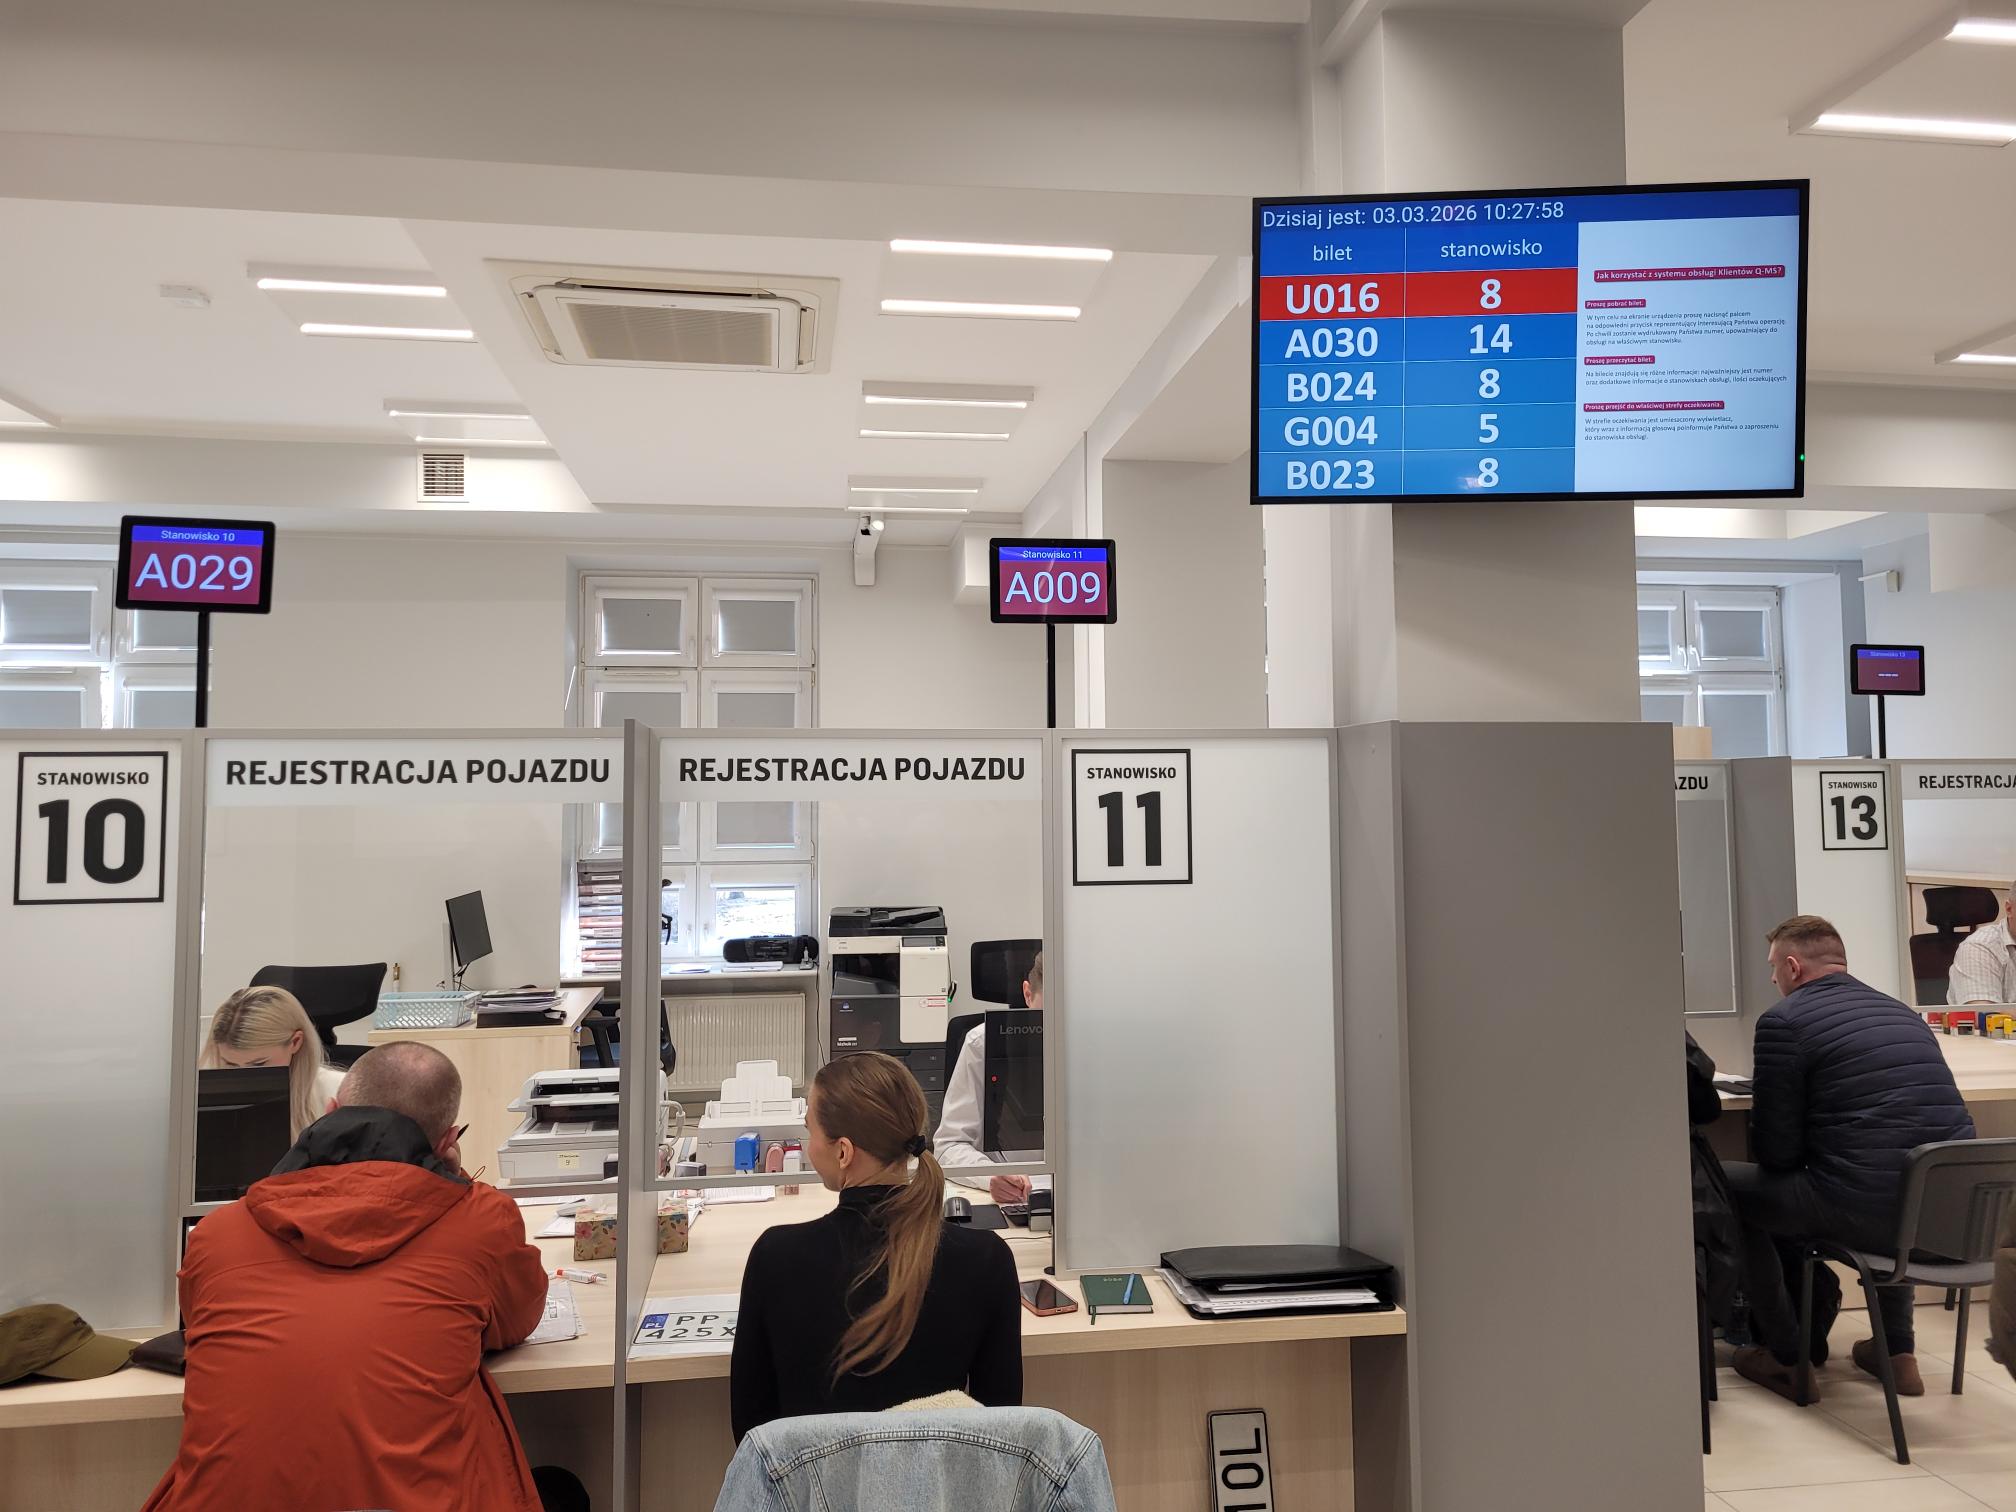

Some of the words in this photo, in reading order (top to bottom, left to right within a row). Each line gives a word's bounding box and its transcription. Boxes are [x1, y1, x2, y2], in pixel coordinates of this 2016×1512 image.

[1263, 209, 1322, 230] Dzisiaj
[1327, 209, 1366, 229] jest:
[1372, 204, 1477, 224] 03.03.2026
[1483, 201, 1564, 221] 10:27:58
[1313, 244, 1352, 261] bilet
[1440, 238, 1543, 257] stanowisko
[1611, 271, 1646, 280] korzystać
[1688, 269, 1716, 277] obsługi
[1287, 282, 1379, 314] U016
[1480, 278, 1502, 309] 8
[1285, 326, 1378, 358] A030
[1470, 323, 1513, 354] 14
[1288, 371, 1376, 401] B024
[1479, 368, 1501, 398] 8
[1285, 415, 1377, 446] G004
[1479, 413, 1499, 443] 5
[1288, 460, 1375, 490] B023
[1477, 458, 1499, 488] 8
[160, 530, 220, 541] Stanowisko
[222, 532, 236, 542] 10
[1022, 550, 1070, 560] Stanowisko
[1072, 550, 1083, 559] 11
[136, 553, 253, 591] A029
[1004, 572, 1101, 604] A009
[37, 771, 149, 786] STANOWISKO
[227, 760, 457, 785] REJESTRACJA
[467, 759, 609, 783] POJAZDU
[680, 758, 888, 782] REJESTRACJA
[895, 757, 1025, 781] POJAZDU
[1087, 767, 1177, 780] STANOWISKO
[1828, 781, 1878, 789] STANOWISKO
[1098, 791, 1162, 867] 11
[1831, 796, 1878, 840] 13
[38, 798, 146, 884] 10
[1000, 1024, 1042, 1035] Lenovo
[644, 1326, 736, 1339] 425X
[676, 1314, 720, 1326] PP
